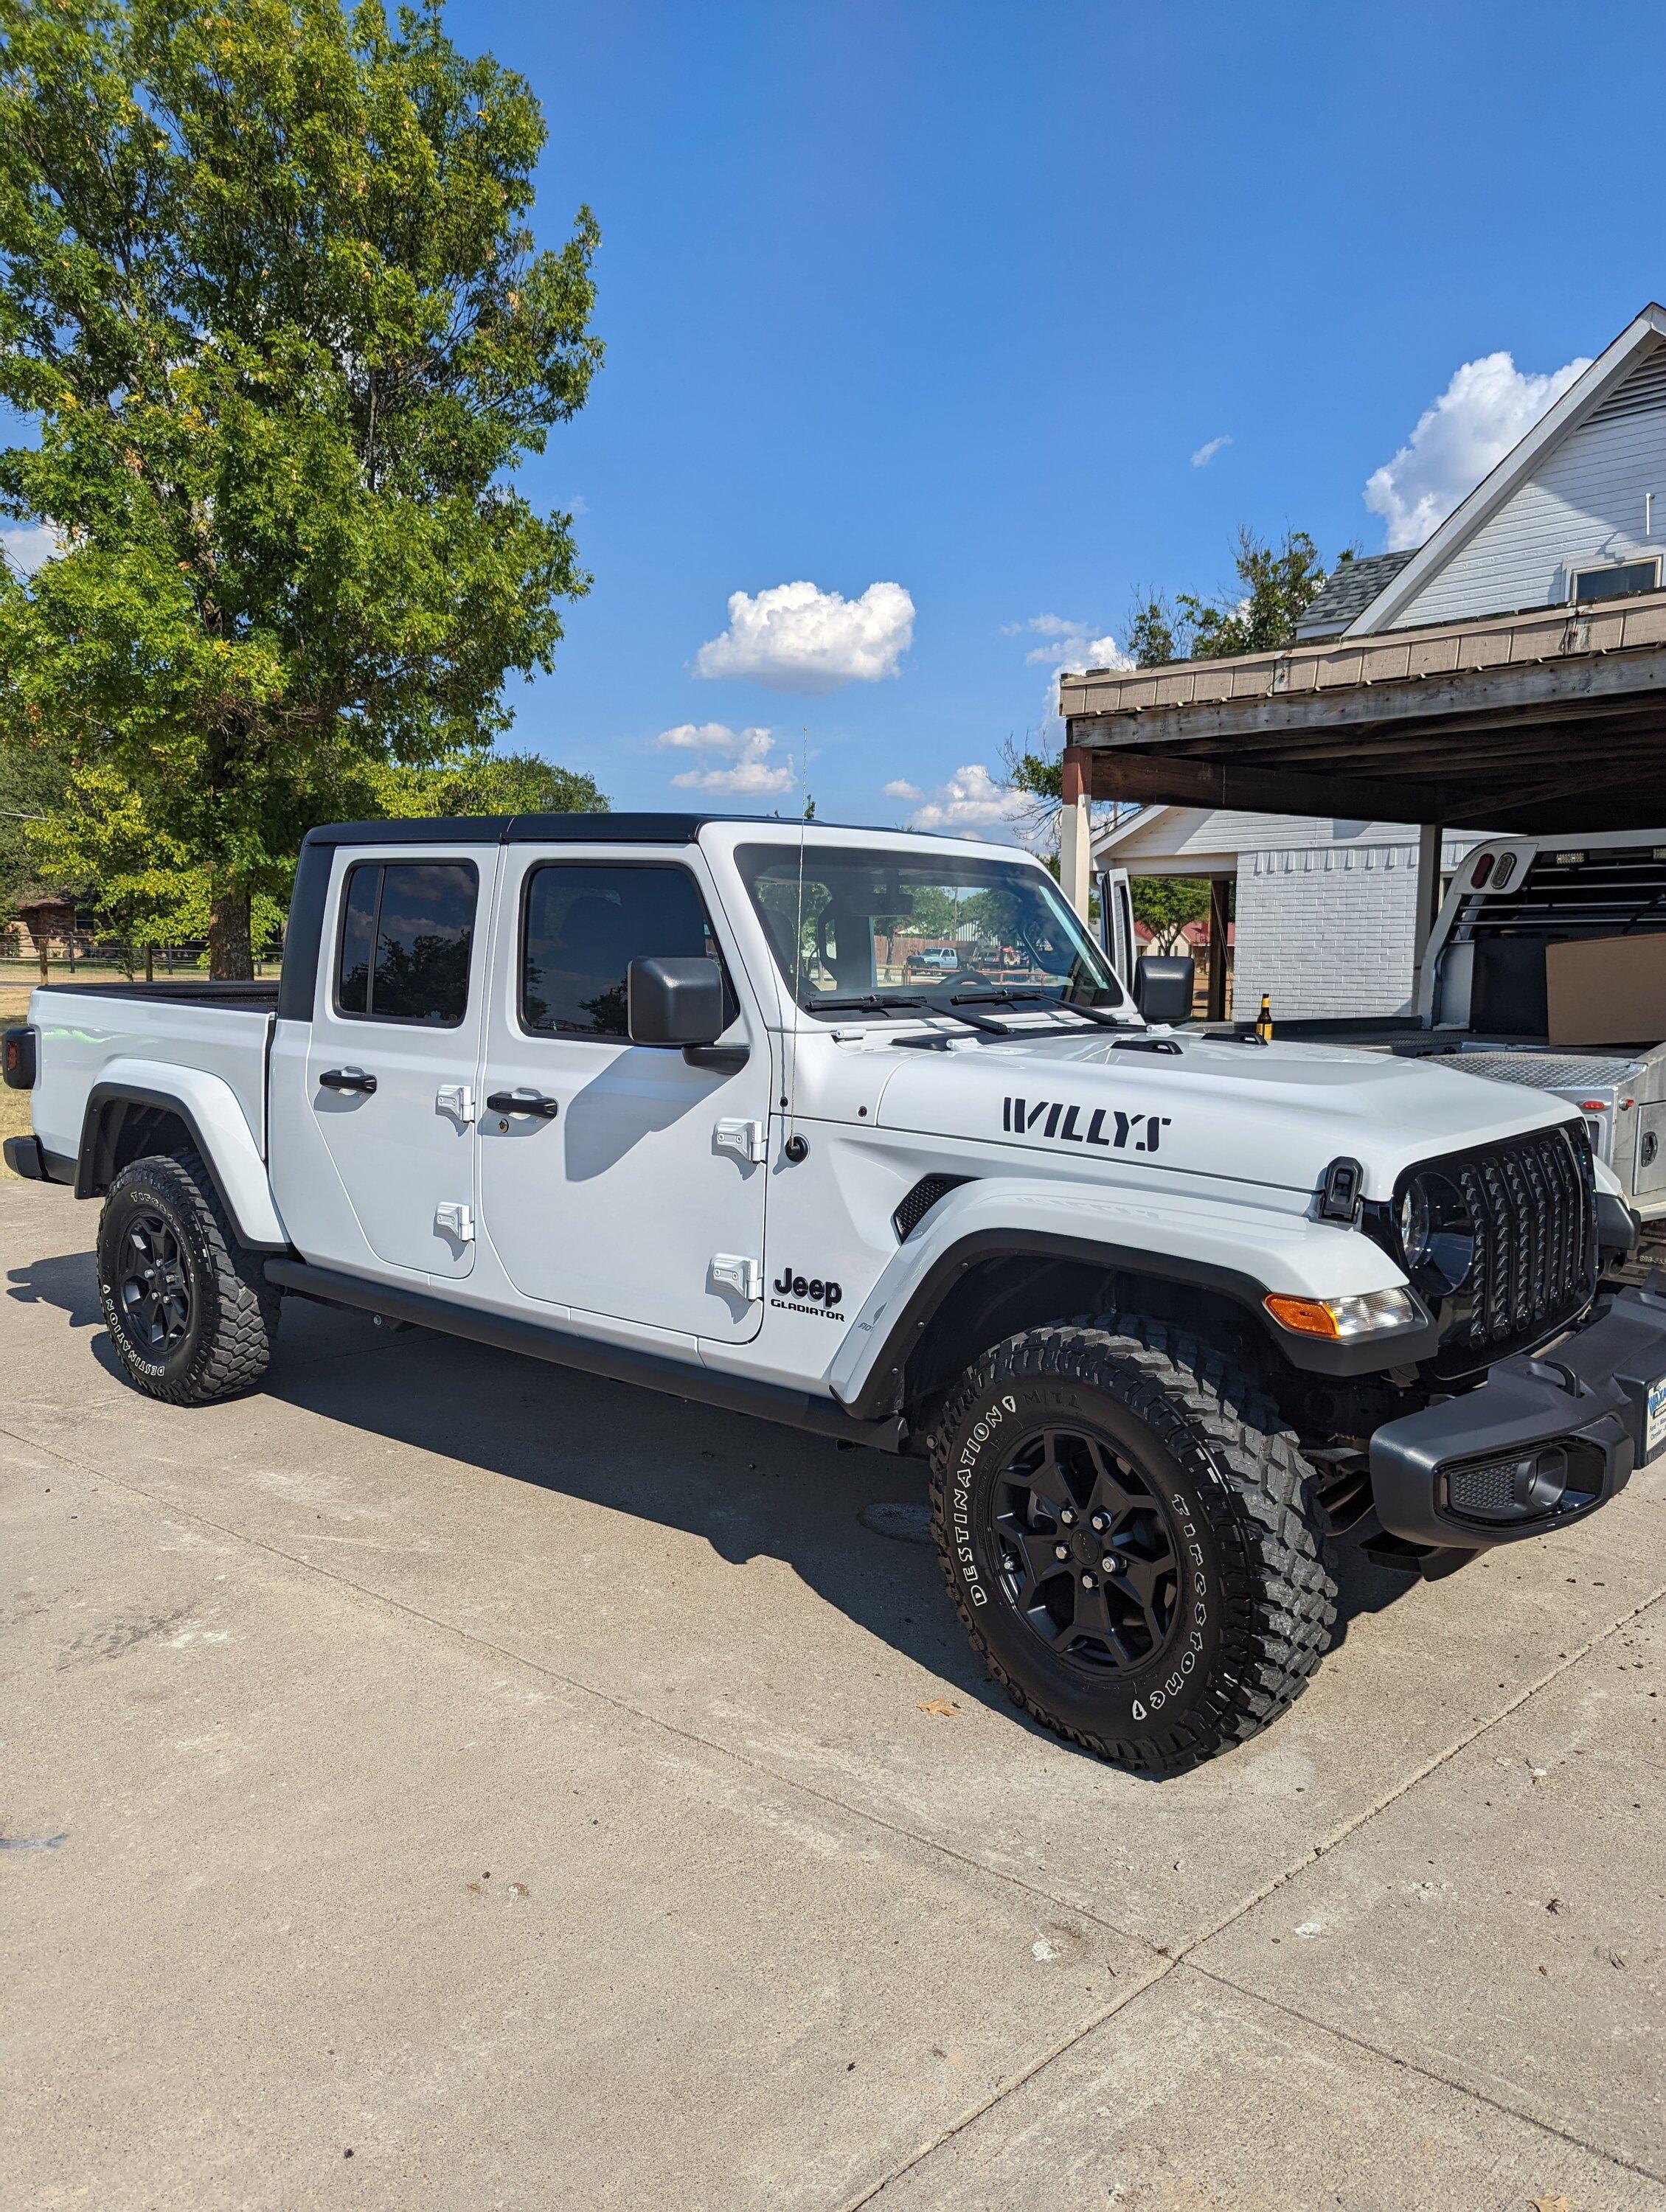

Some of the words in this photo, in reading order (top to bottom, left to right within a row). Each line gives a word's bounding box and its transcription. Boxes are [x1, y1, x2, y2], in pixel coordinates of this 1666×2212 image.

[1004, 1096, 1172, 1152] WILLYS
[771, 1298, 845, 1322] GLADIATOR
[774, 1267, 842, 1307] Jeep
[105, 1298, 165, 1377] DESTINATION
[953, 1405, 1004, 1606] DESTINATION
